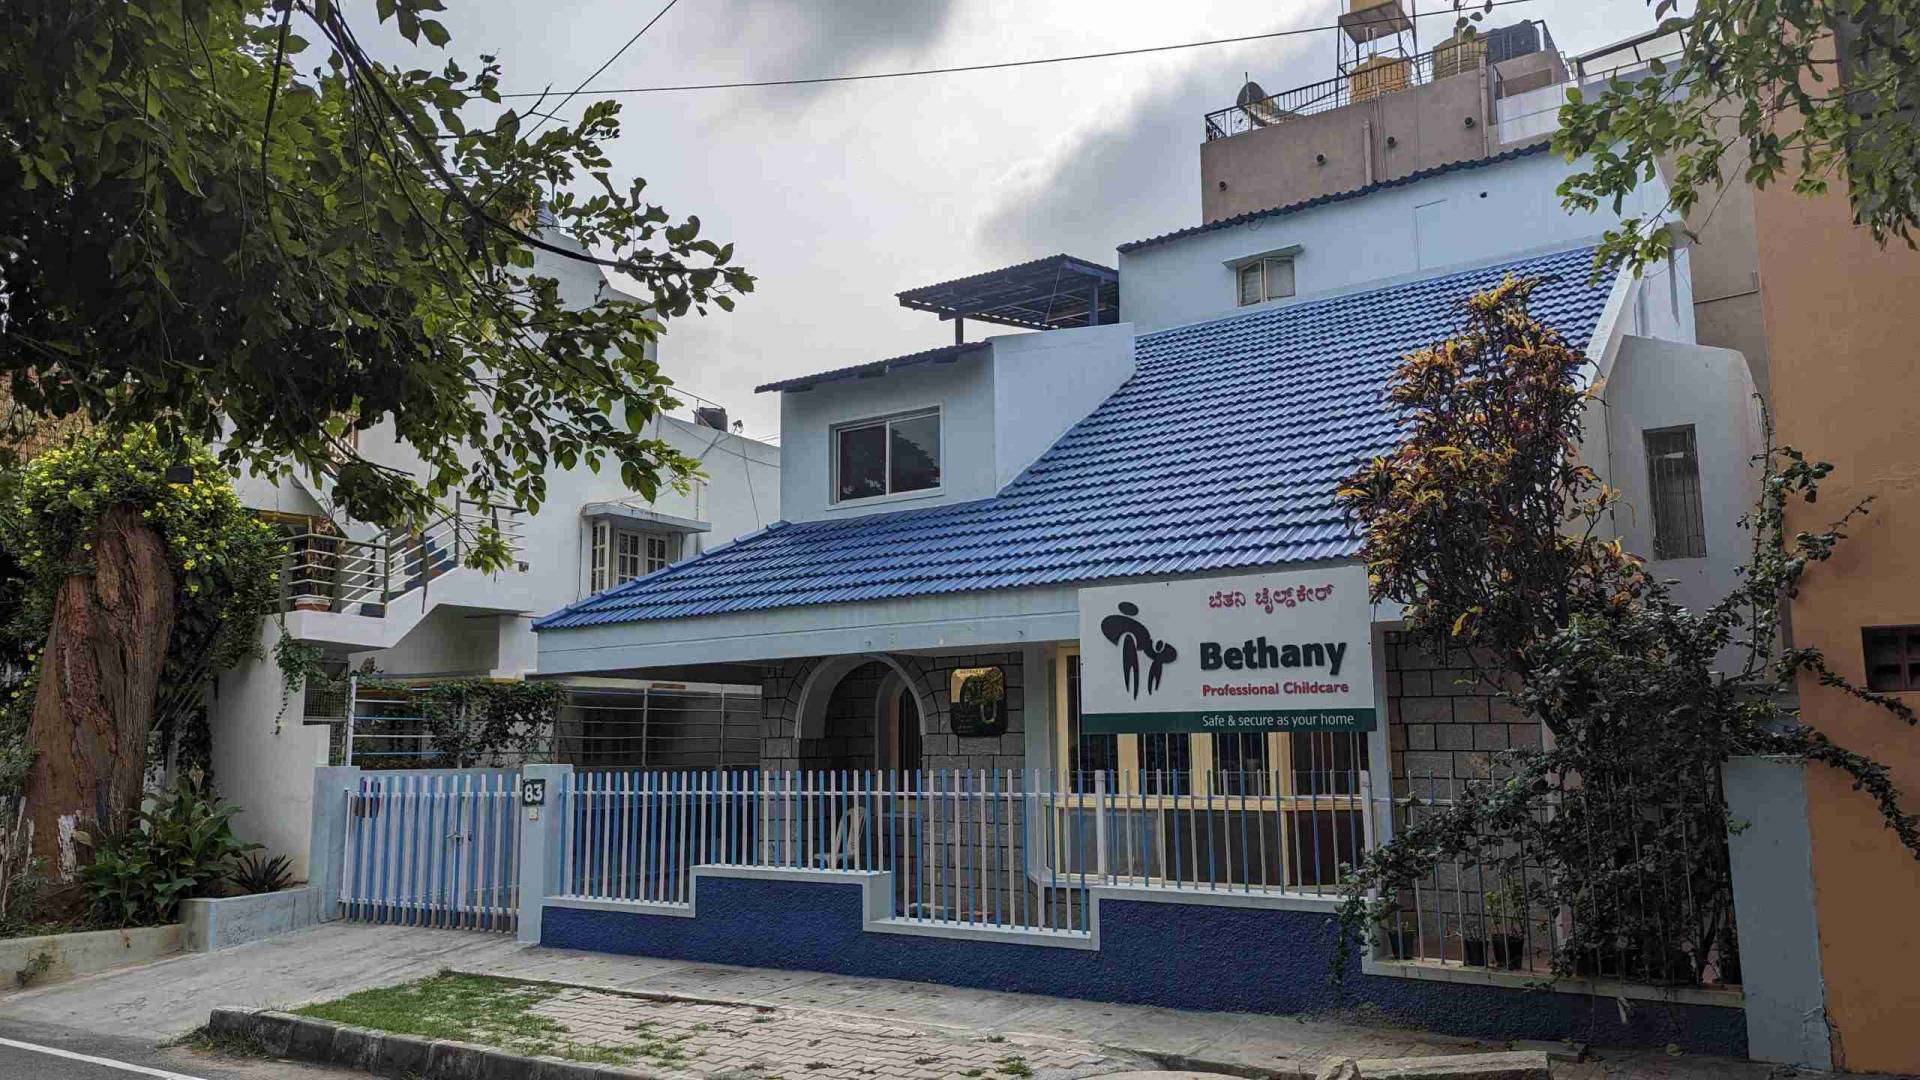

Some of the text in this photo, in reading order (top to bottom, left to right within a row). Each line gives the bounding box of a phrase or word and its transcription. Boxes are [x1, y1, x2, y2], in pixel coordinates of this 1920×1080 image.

[1200, 637, 1347, 675] Bethany
[1202, 681, 1350, 697] Professional Childcare
[1202, 713, 1355, 729] Safe & secure as your home
[524, 783, 543, 802] 83
